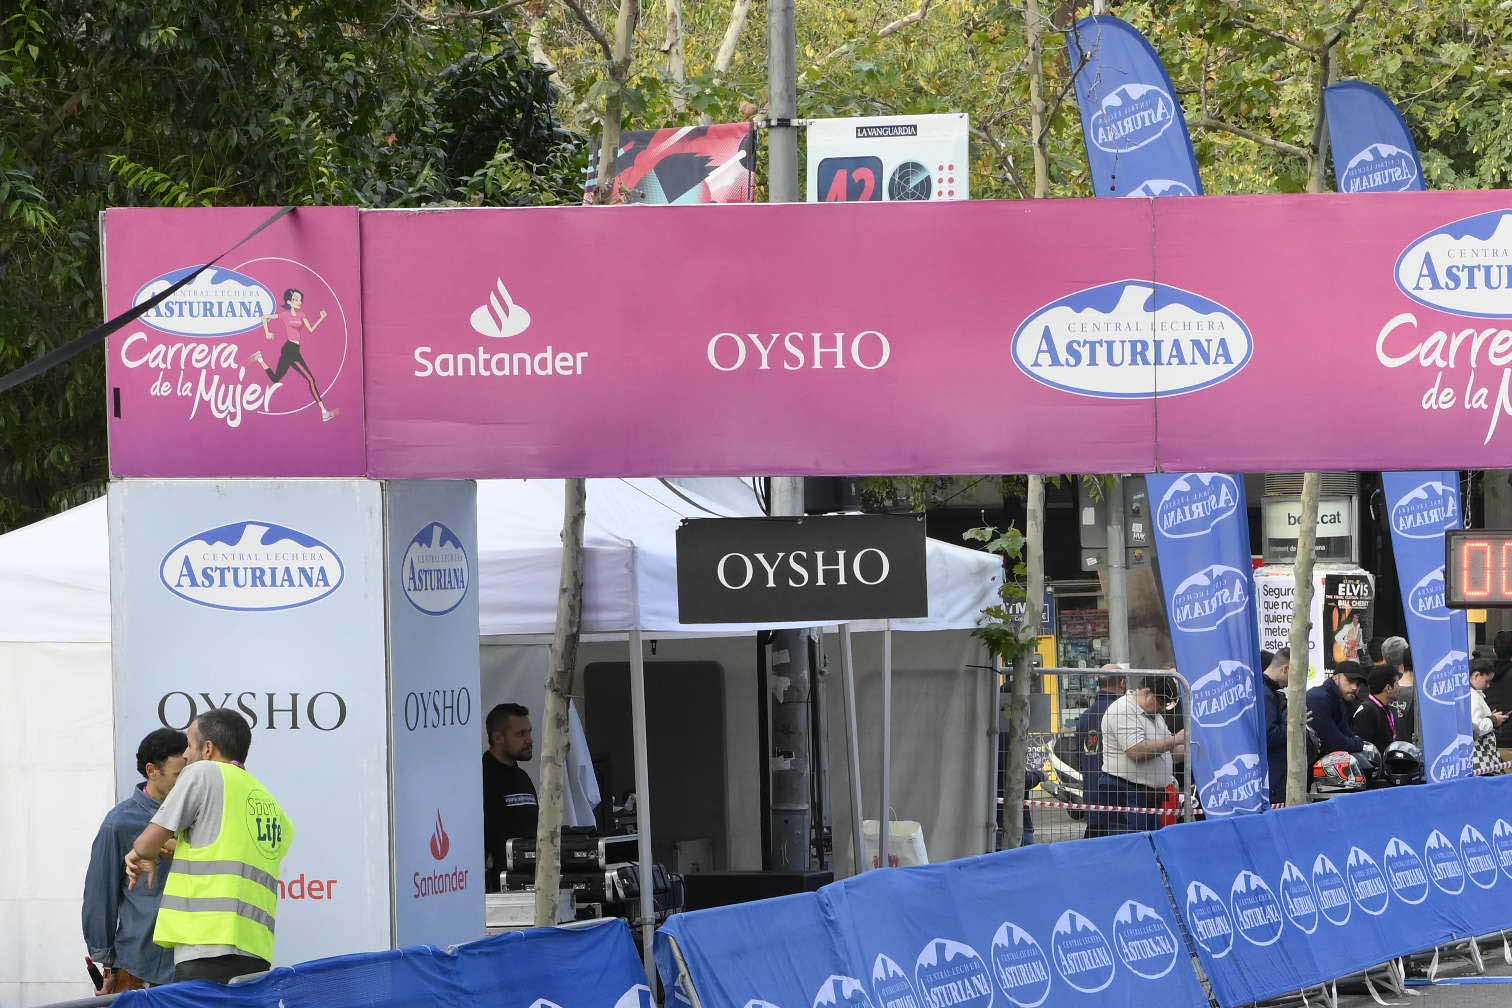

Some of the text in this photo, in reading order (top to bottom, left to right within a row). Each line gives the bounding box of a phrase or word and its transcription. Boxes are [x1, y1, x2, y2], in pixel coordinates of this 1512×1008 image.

[1067, 319, 1227, 333] CENTRAL LECHERA
[121, 332, 239, 369] Carrera
[414, 345, 589, 377] Santander
[707, 330, 891, 371] OYSHO
[1030, 325, 1235, 368] ASTURIANA
[150, 366, 284, 427] de la Mujer
[1421, 372, 1456, 410] de
[1464, 370, 1488, 410] la
[174, 554, 331, 588] ASTURIANA
[202, 552, 325, 561] CENTRAL LECHERA
[716, 548, 890, 590] OYSHO
[407, 557, 465, 592] ASTURIANA
[1338, 583, 1368, 596] ELVIS
[404, 686, 471, 731] OYSHO
[413, 868, 469, 899] Santander
[997, 957, 1048, 990] ASTURIANA
[1057, 944, 1112, 976] ASTURIANA
